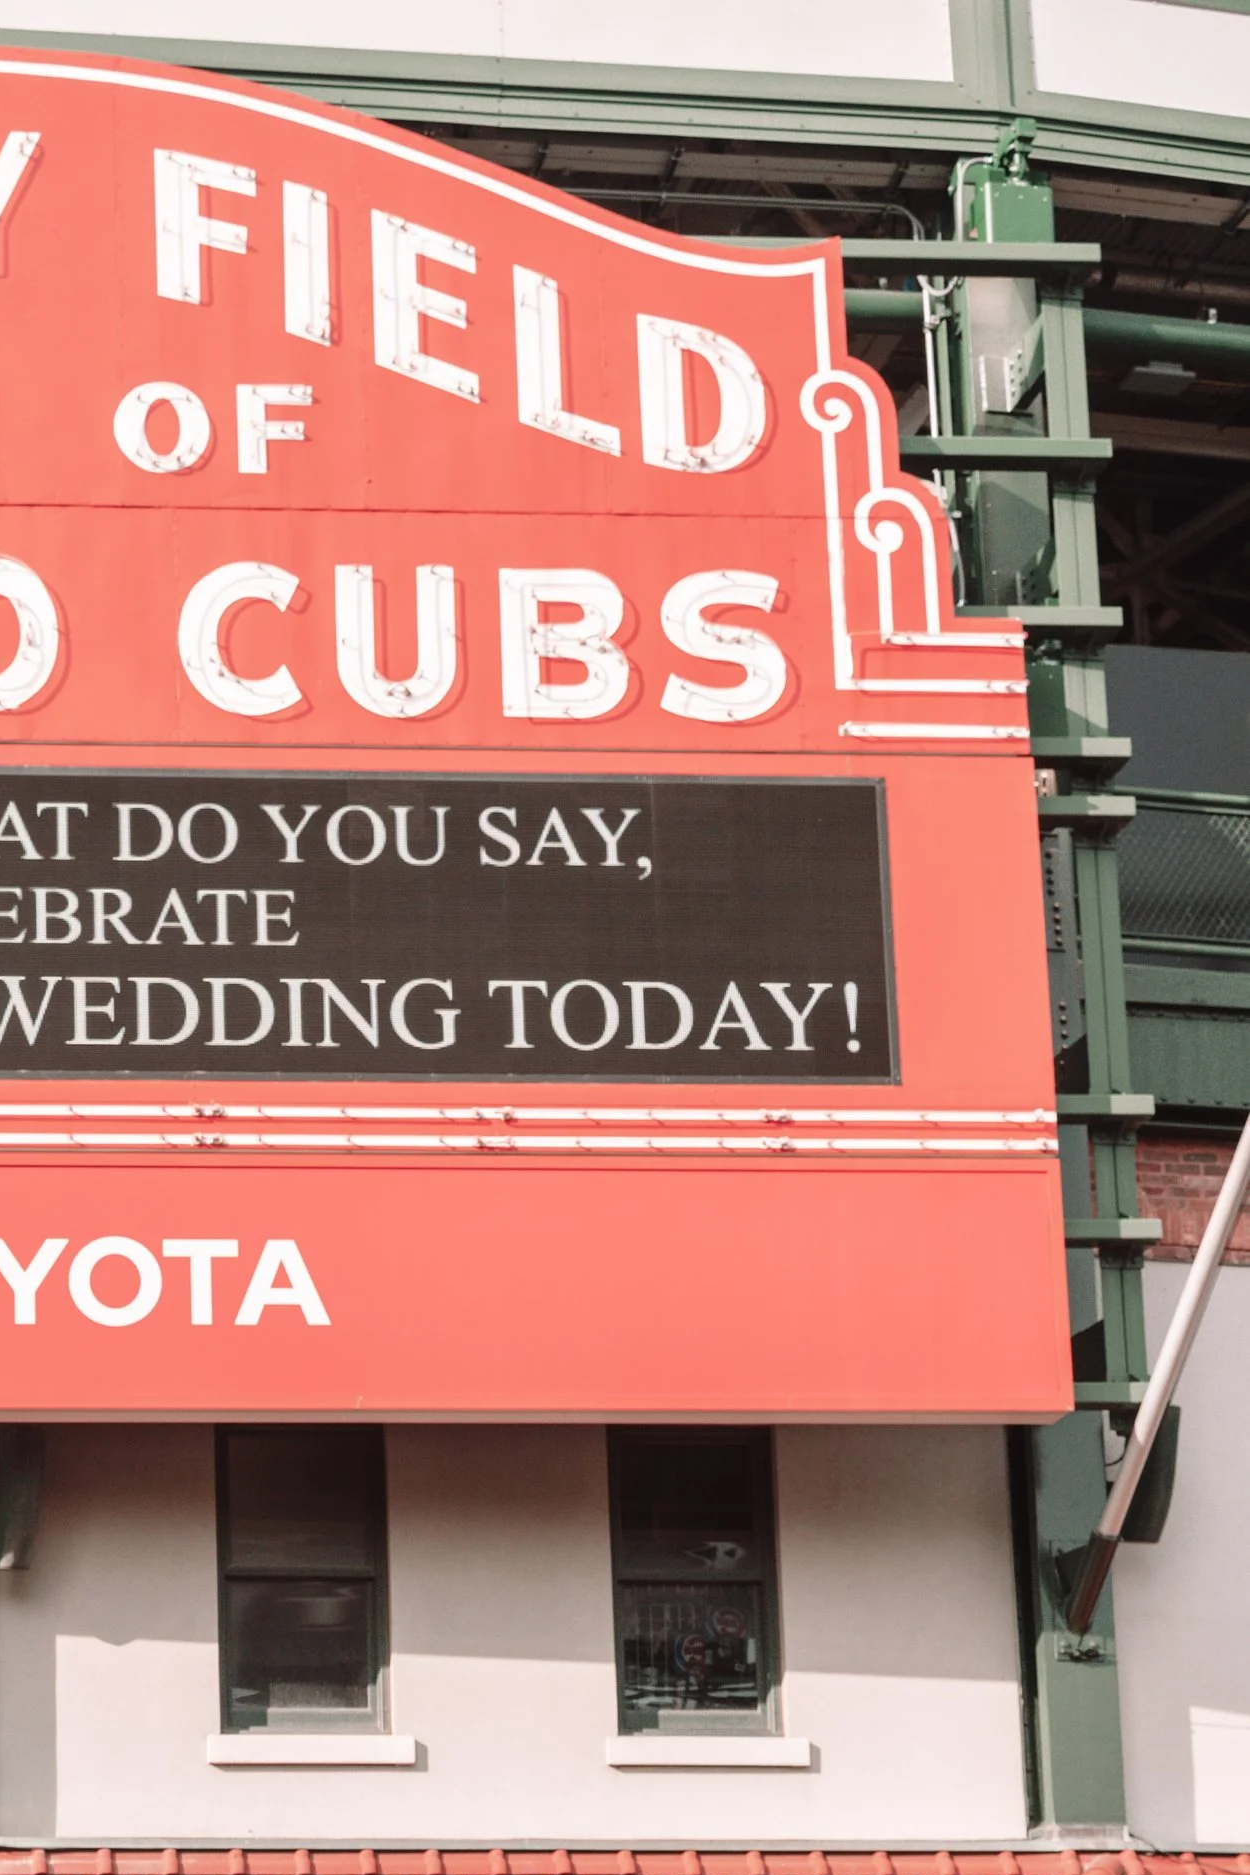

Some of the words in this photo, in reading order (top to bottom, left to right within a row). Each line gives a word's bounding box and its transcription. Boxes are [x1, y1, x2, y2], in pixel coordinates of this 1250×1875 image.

[153, 148, 767, 474] FIELD
[114, 383, 313, 474] OF
[179, 563, 786, 721] CUBS
[113, 803, 239, 864] DO
[262, 805, 449, 866] YOU
[479, 807, 652, 880] SAY,
[489, 980, 861, 1053] TODAY!
